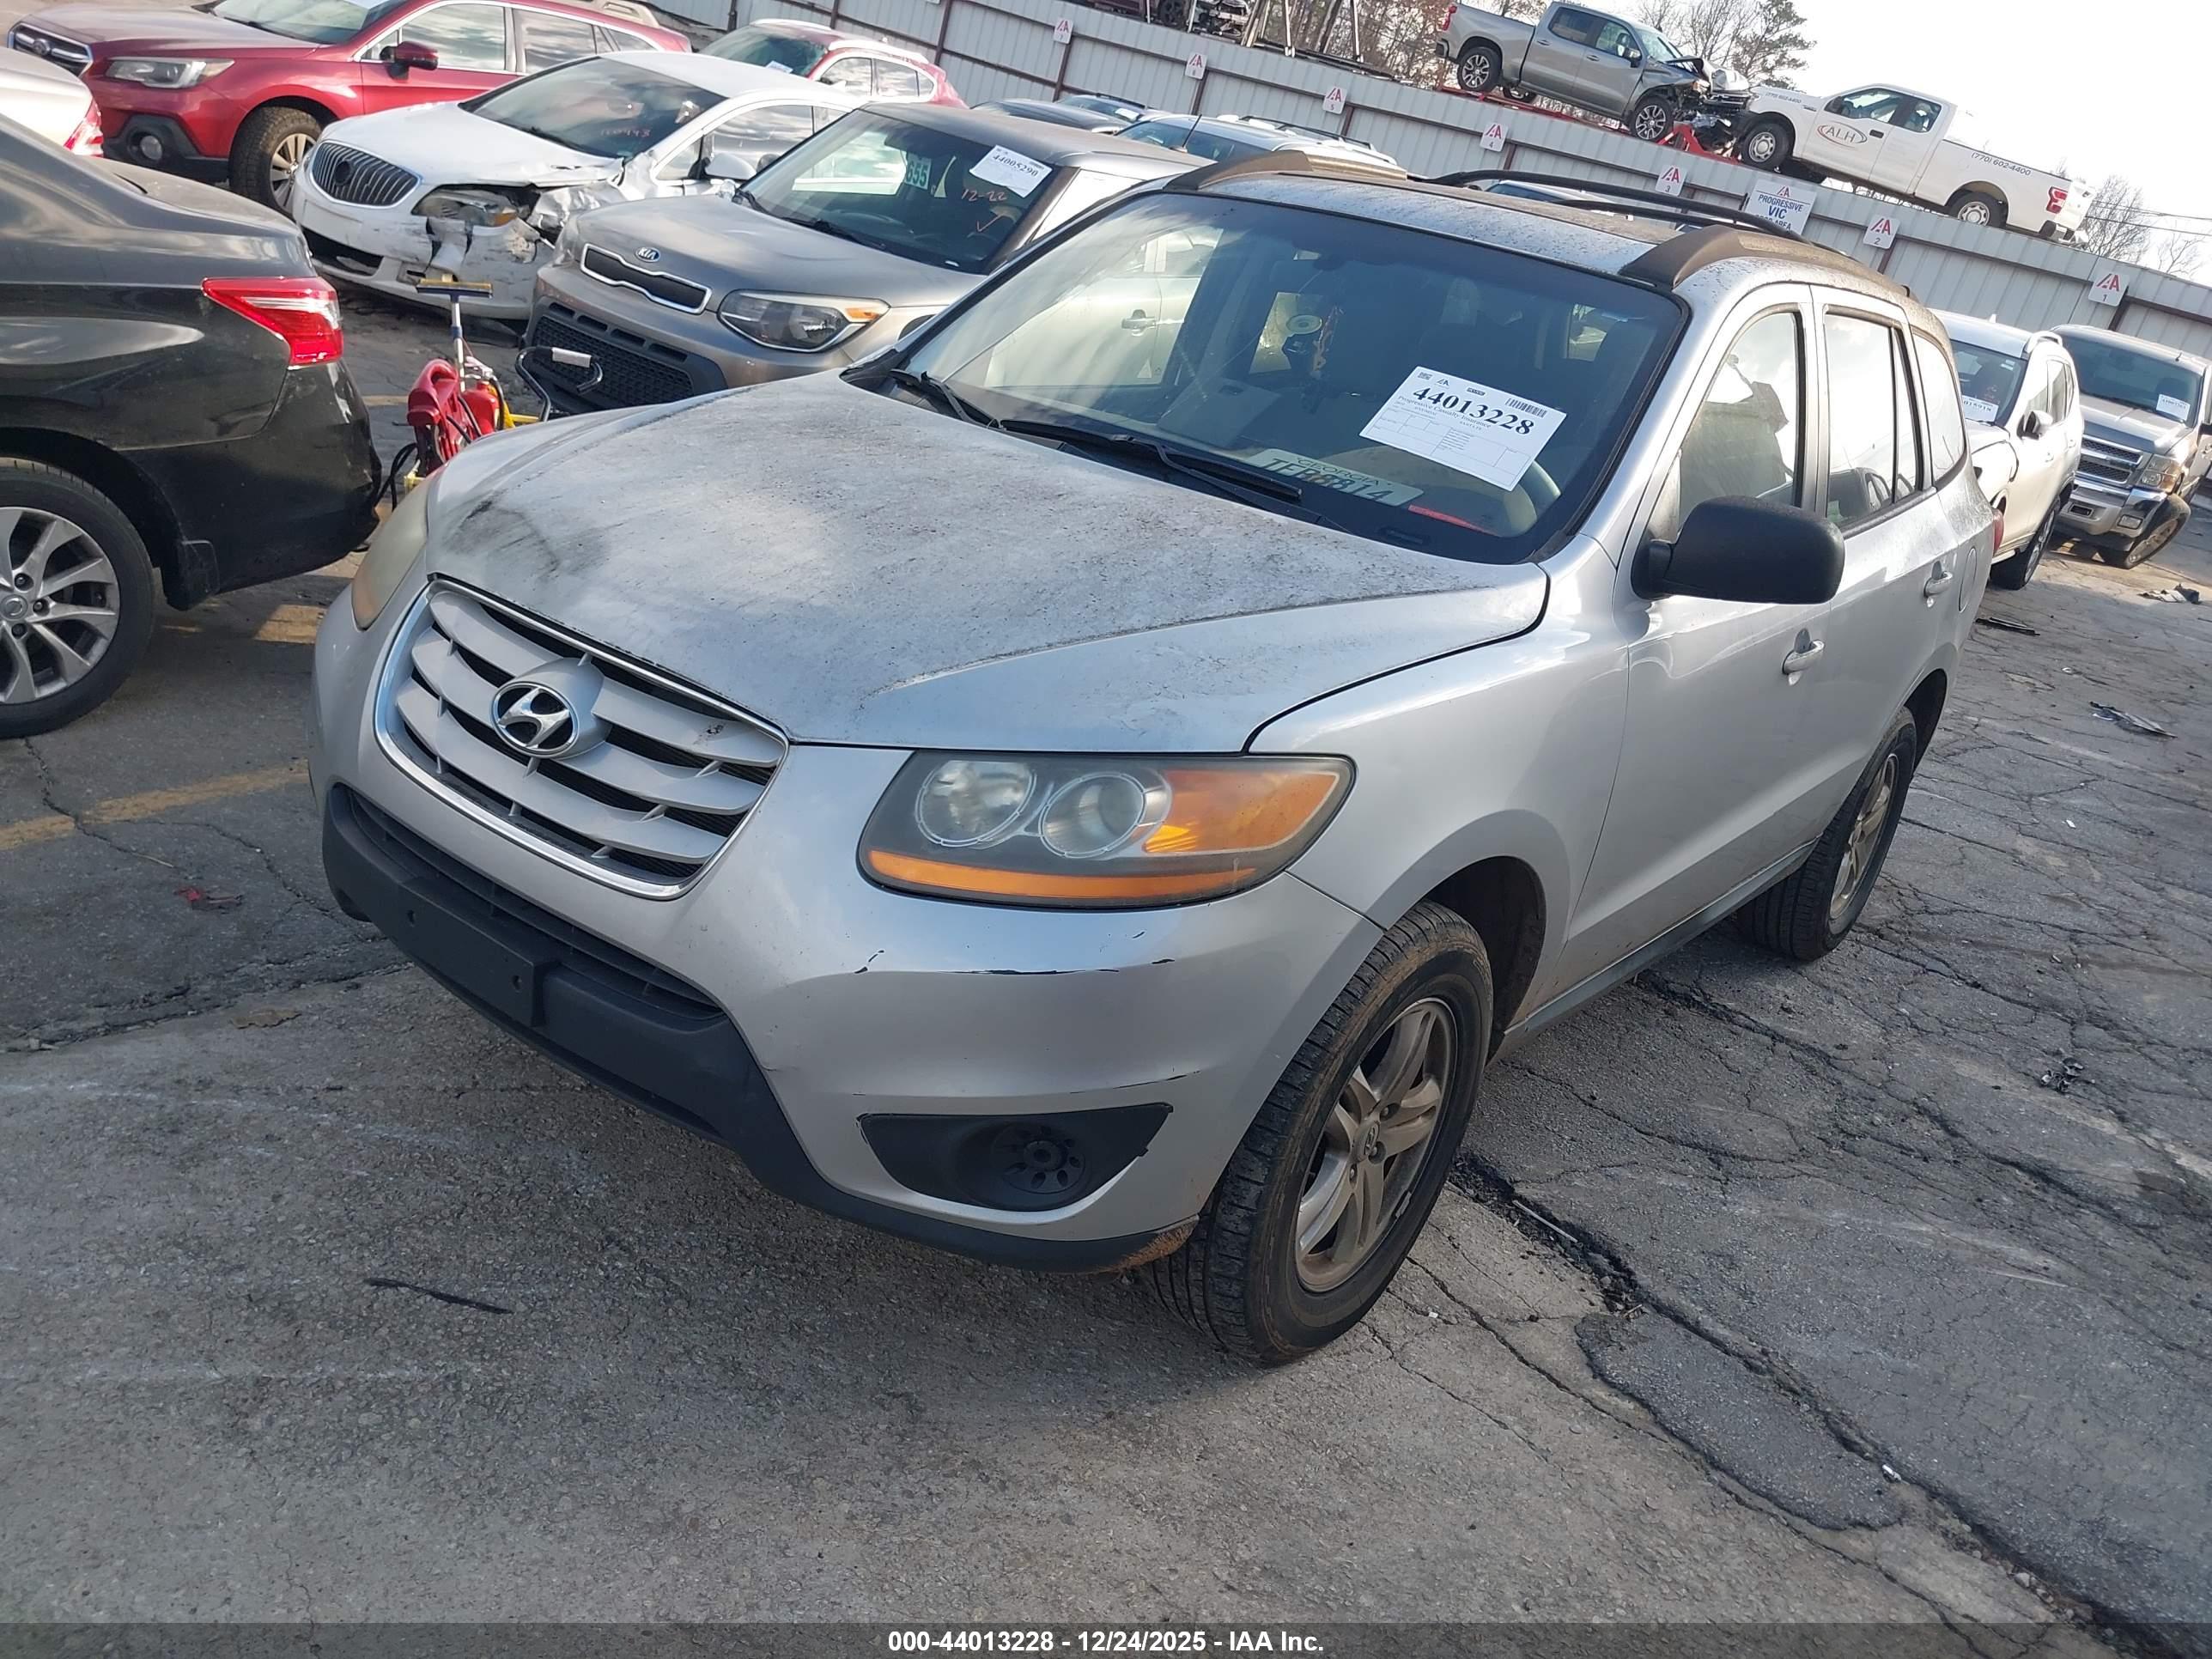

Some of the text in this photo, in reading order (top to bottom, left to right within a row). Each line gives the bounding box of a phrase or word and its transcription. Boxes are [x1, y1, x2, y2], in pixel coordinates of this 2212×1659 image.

[1825, 126, 1855, 143] ALH
[993, 155, 1039, 177] 44005290
[1971, 151, 2032, 176] (770) 602-4400
[961, 187, 1007, 202] 12-22
[1758, 193, 1804, 213] PROGRESSIVE
[1767, 204, 1788, 220] VIC
[1397, 396, 1433, 410] Progressive
[1433, 406, 1459, 419] Casualty
[1462, 415, 1492, 428] Insurance
[1413, 387, 1534, 434] 44013228
[1297, 457, 1381, 487] GEORGIA
